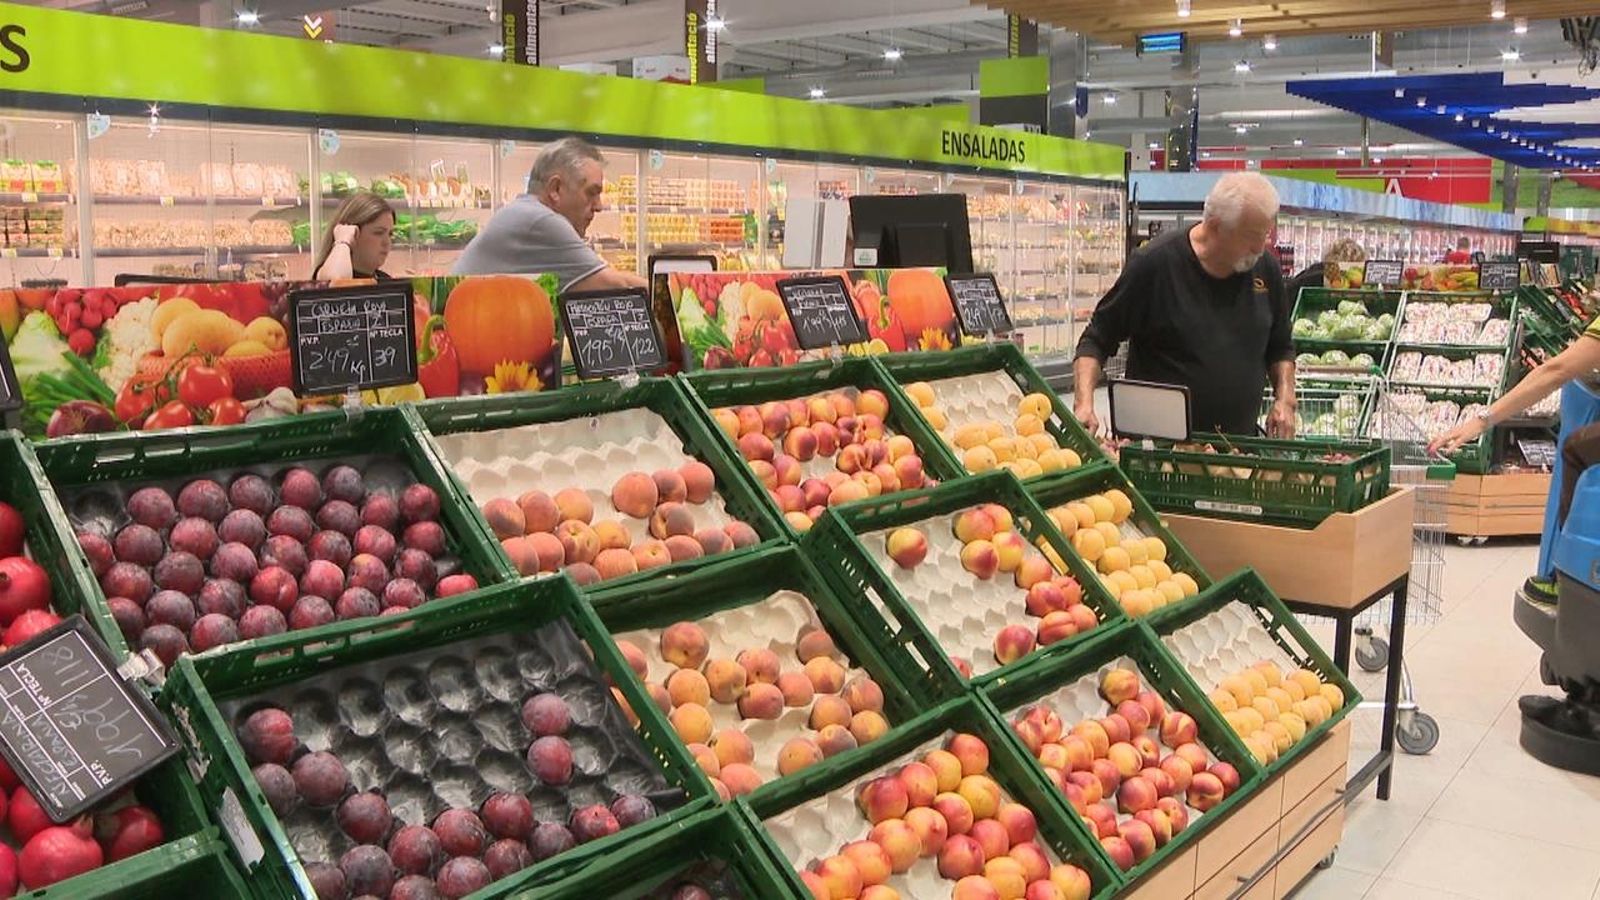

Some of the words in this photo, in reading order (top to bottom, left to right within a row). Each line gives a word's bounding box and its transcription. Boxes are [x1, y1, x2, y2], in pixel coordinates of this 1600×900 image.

[942, 130, 1025, 163] ENSALADAS
[379, 328, 404, 338] TECLA
[375, 346, 396, 367] 39
[581, 339, 614, 367] 1,95
[631, 337, 655, 361] 122
[16, 663, 43, 697] TECLA
[42, 646, 89, 687] 118
[89, 758, 115, 786] P.V.P.
